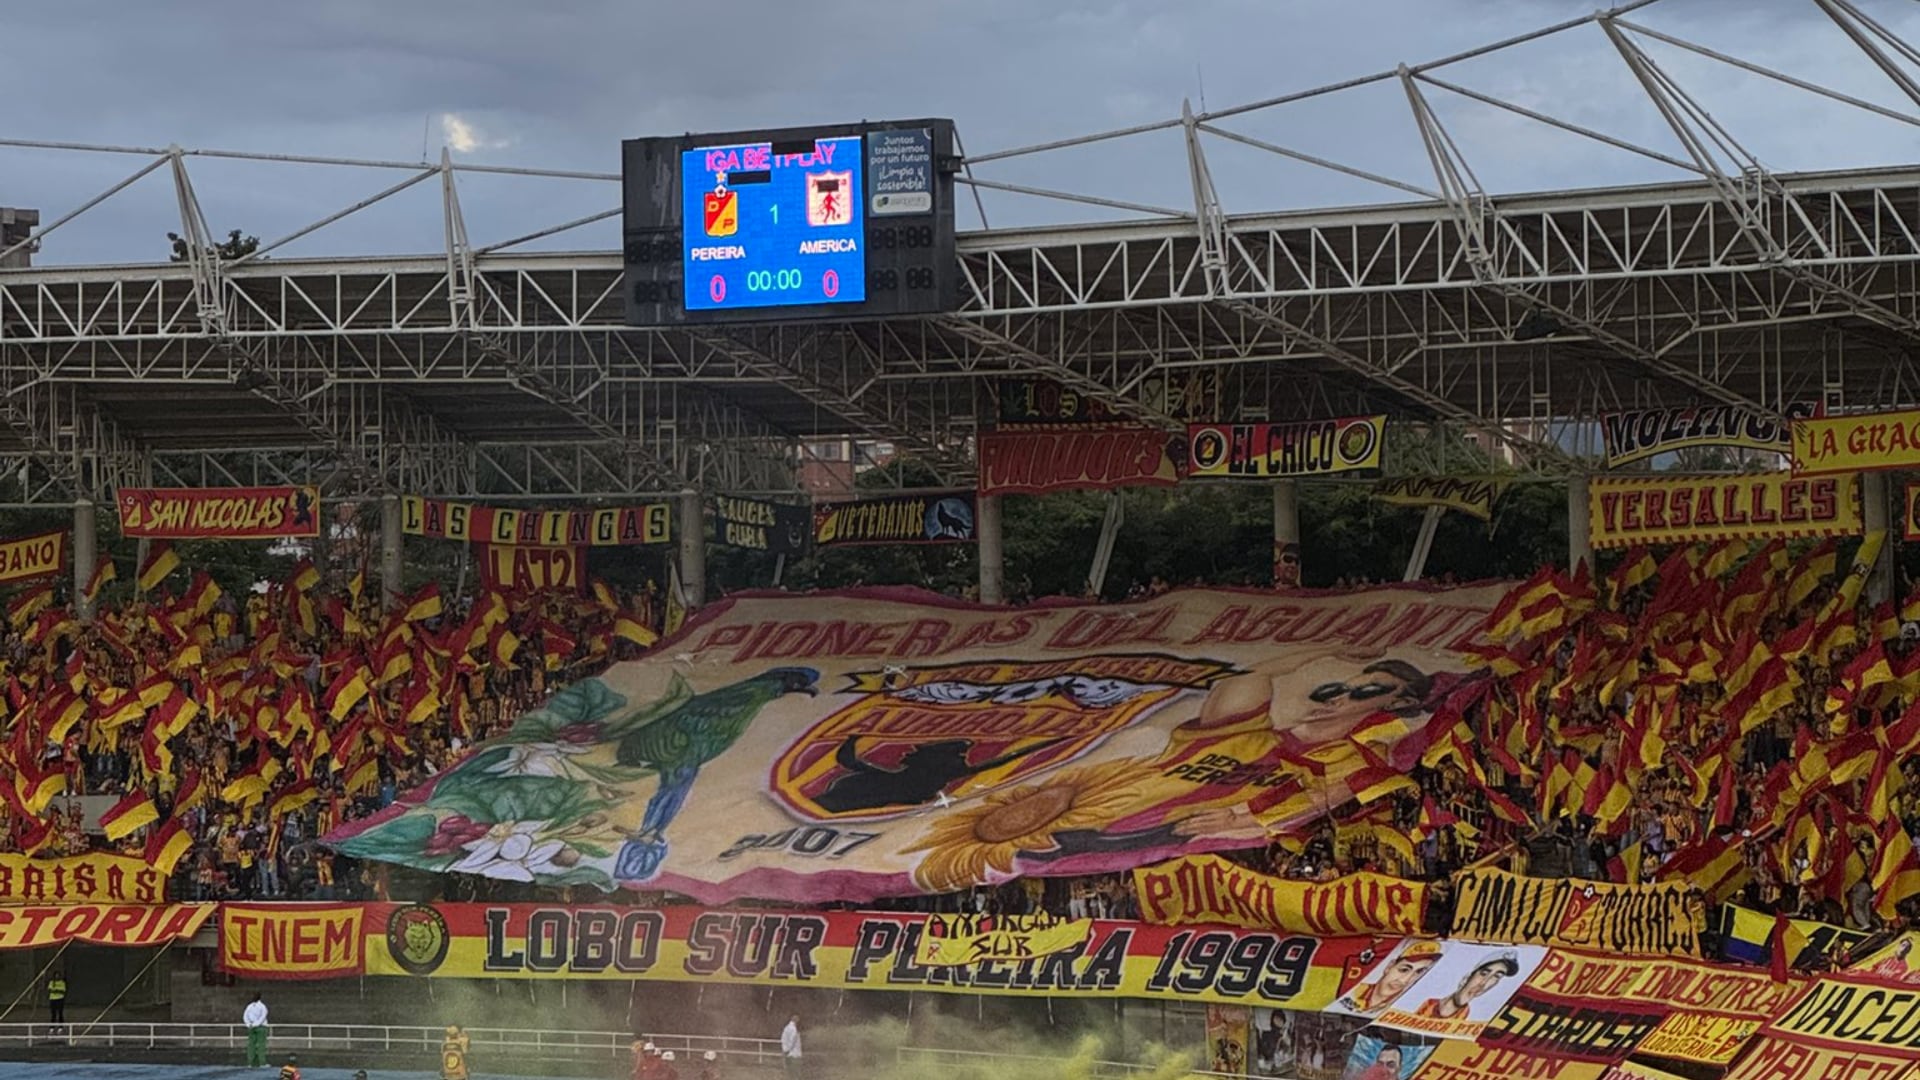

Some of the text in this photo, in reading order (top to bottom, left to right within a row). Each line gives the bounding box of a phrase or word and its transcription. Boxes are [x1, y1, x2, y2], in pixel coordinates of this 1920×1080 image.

[874, 145, 926, 155] trabajamos
[884, 136, 915, 145] Juntos
[870, 153, 930, 165] por un futuro
[708, 201, 720, 212] D
[769, 204, 779, 224] 1
[723, 218, 735, 229] P
[691, 246, 746, 261] PEREIRA
[799, 239, 857, 254] AMERICA
[710, 275, 727, 303] 0
[747, 269, 802, 291] 00:00
[822, 269, 840, 297] 0
[1229, 422, 1336, 474] EL CHICO
[1808, 428, 1839, 462] LA
[145, 496, 287, 530] SAN NICOLAS
[836, 499, 926, 539] VETERANOS
[1601, 478, 1837, 532] VERSALLES
[406, 499, 666, 545] LAS CHINGAS
[694, 612, 1044, 664] PIONERAS
[1046, 605, 1177, 648] DEL
[1301, 879, 1419, 935] VIVE
[1451, 870, 1697, 958] CAMILO TORRES
[230, 916, 353, 965] INEM
[484, 907, 664, 972] LOBO
[683, 913, 828, 980] SUR
[1146, 930, 1320, 999] 1999
[1461, 1047, 1571, 1079] JUAN
